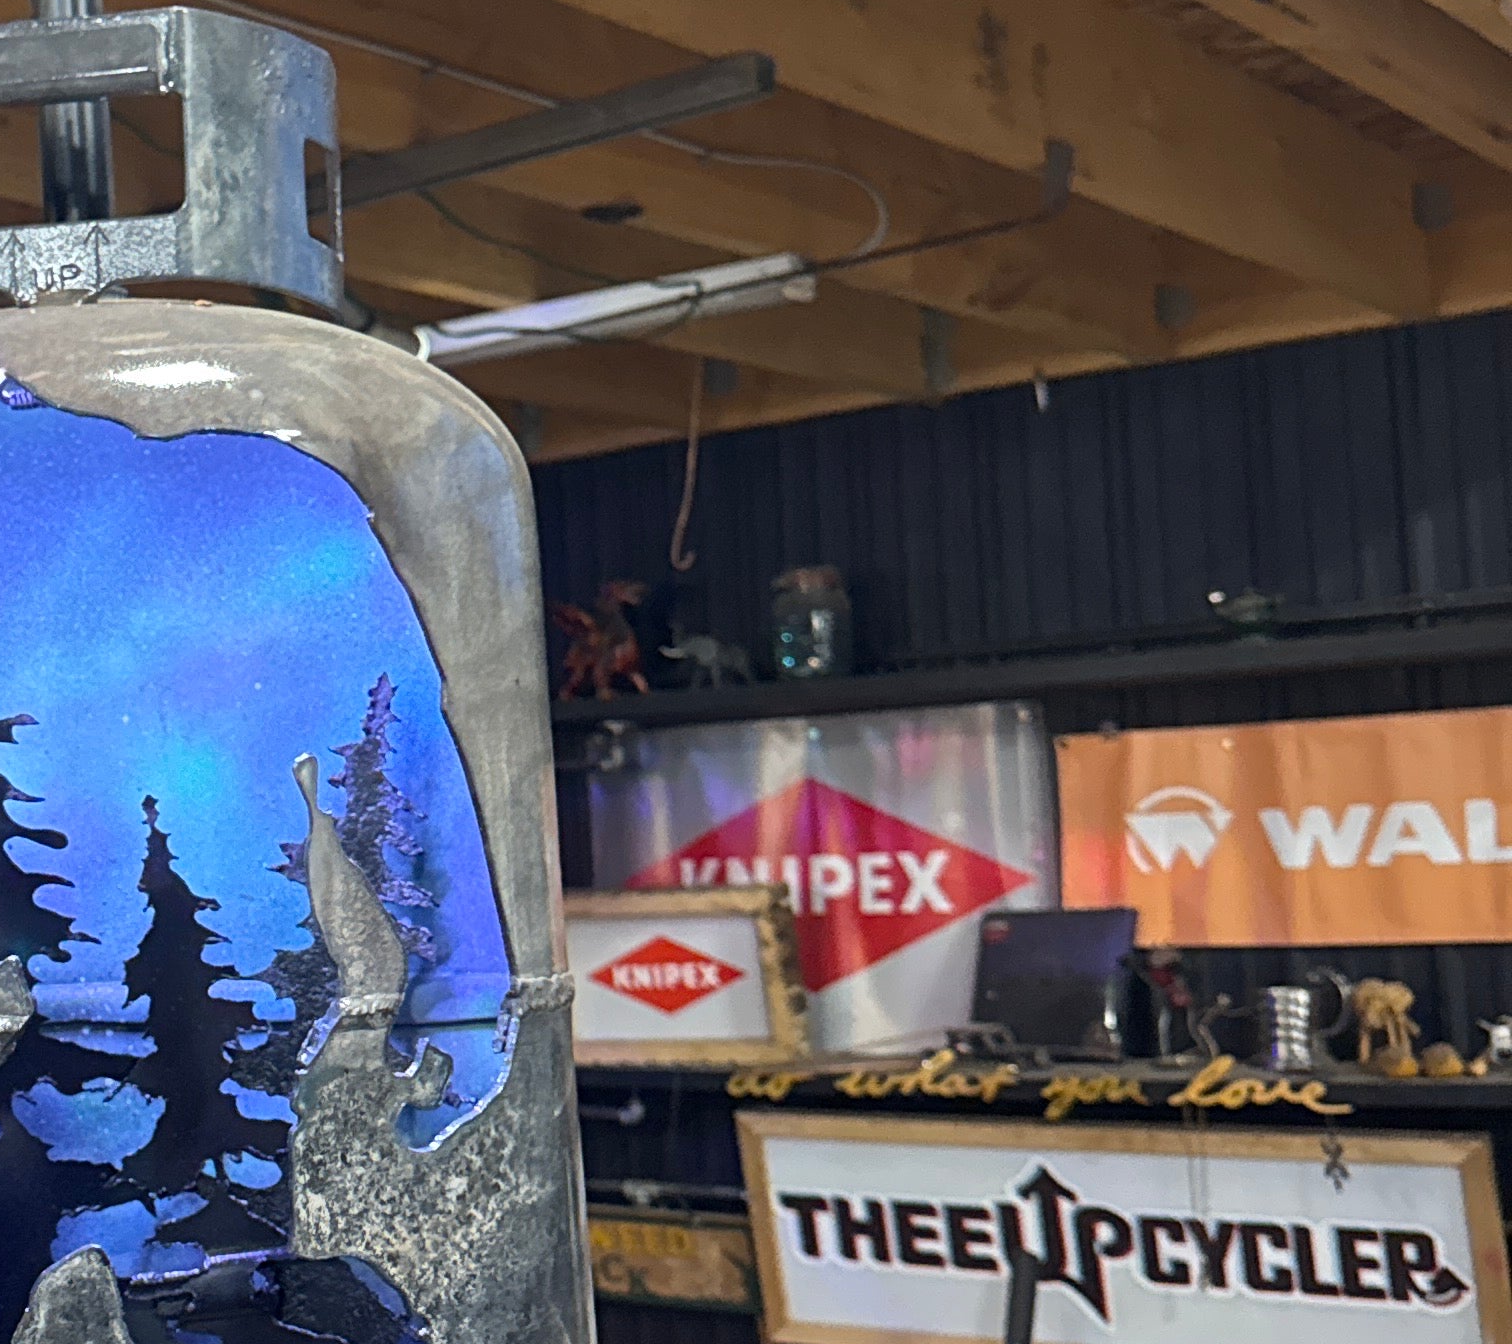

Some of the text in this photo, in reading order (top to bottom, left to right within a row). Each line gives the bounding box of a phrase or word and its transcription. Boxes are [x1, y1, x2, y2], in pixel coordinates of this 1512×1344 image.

[31, 262, 82, 292] UP
[611, 961, 723, 992] KNIPEX
[837, 1048, 1019, 1102] what
[1041, 1070, 1152, 1121] you
[1168, 1055, 1354, 1115] love
